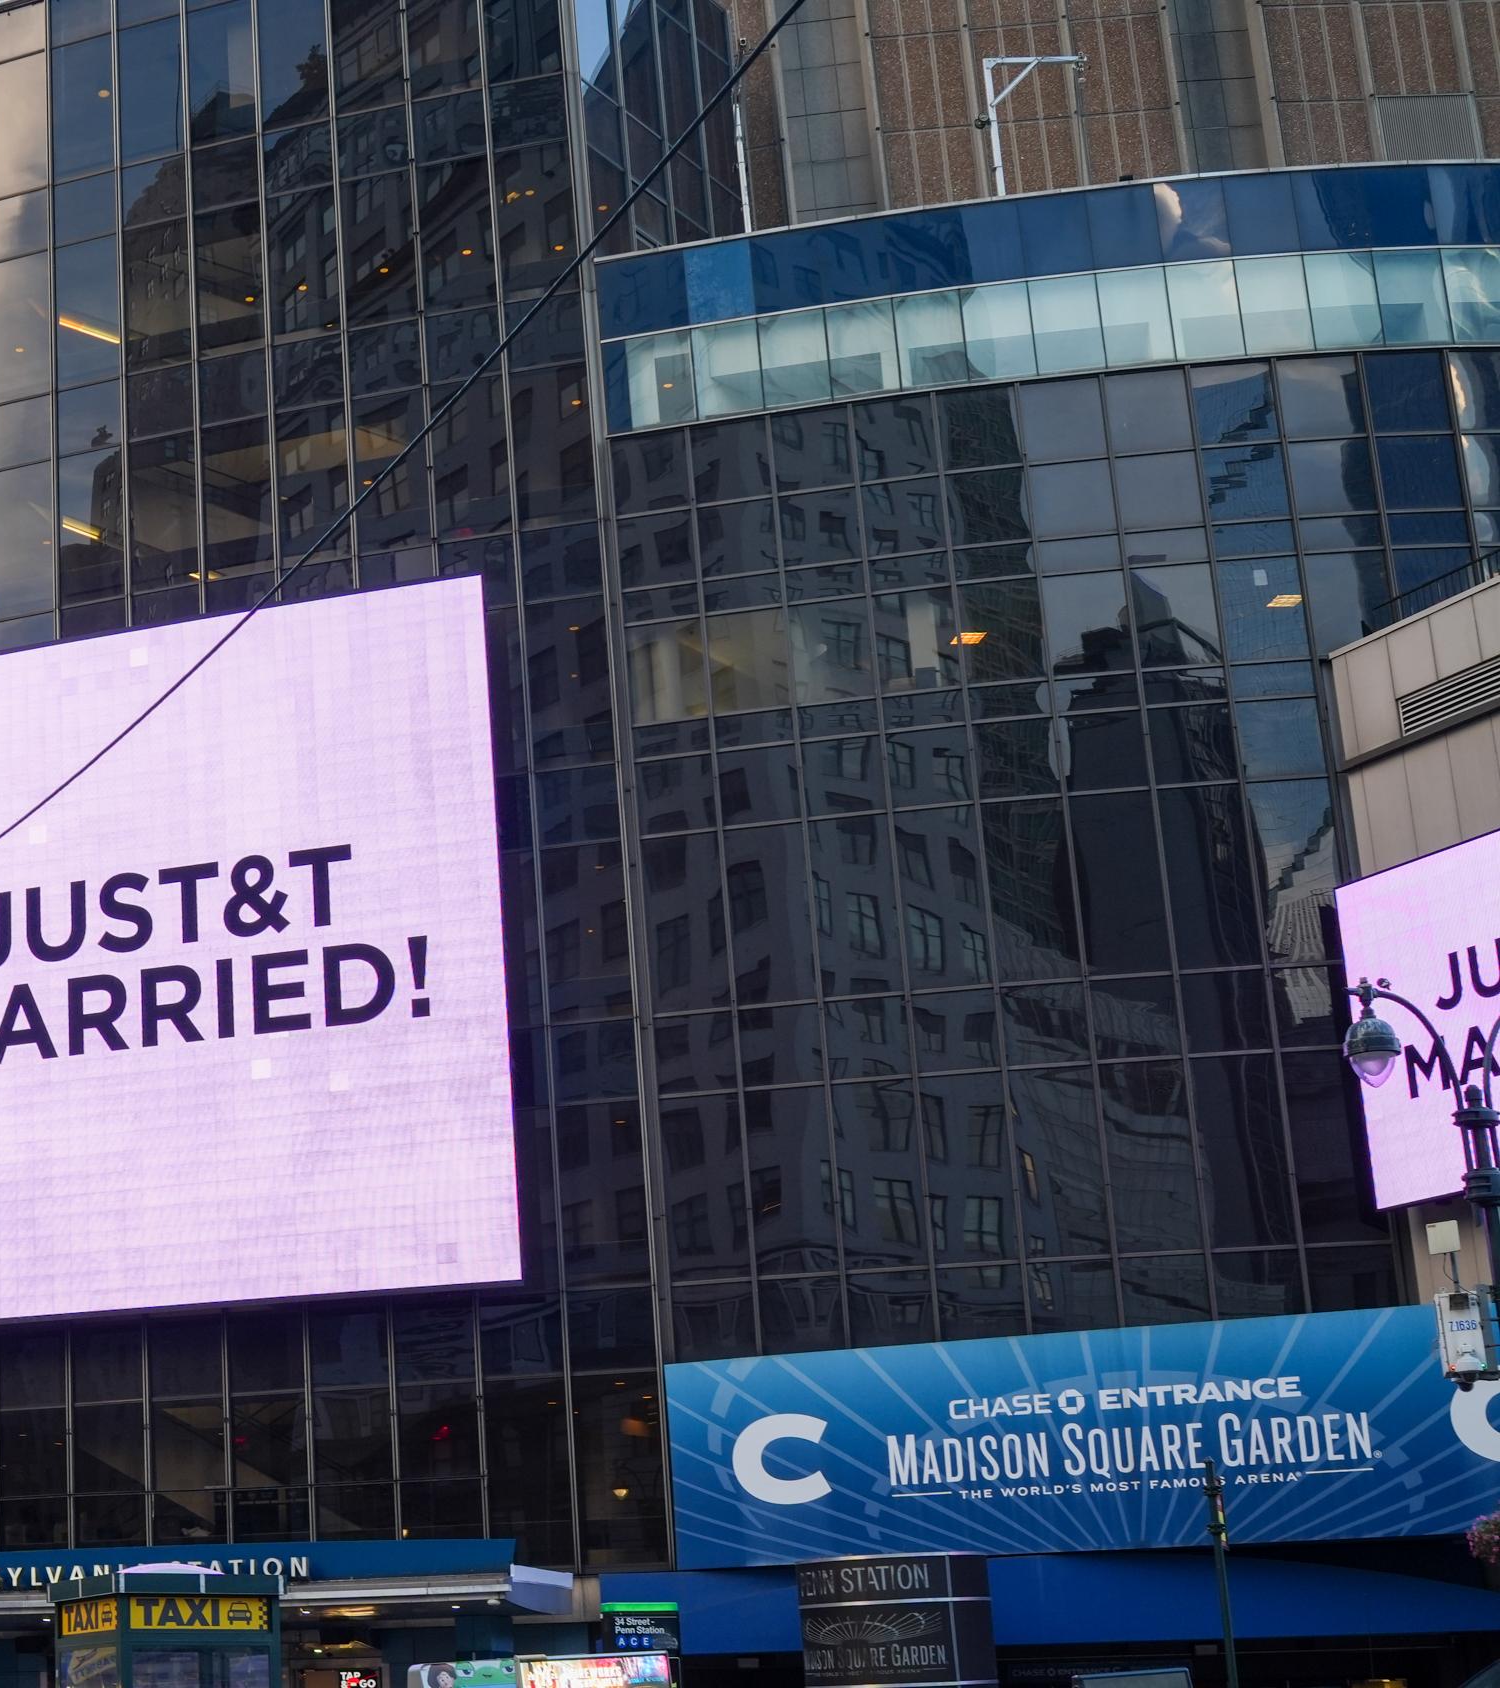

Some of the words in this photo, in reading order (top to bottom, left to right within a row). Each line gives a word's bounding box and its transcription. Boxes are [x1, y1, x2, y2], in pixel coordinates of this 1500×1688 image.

[948, 1393, 1053, 1420] CHASE
[1098, 1375, 1302, 1411] ENTRANCE
[732, 1413, 832, 1505] C
[887, 1432, 1050, 1487] MADISON
[1061, 1422, 1205, 1478] SQUARE
[959, 1488, 993, 1500] THE
[1001, 1484, 1082, 1497] WORLD'S
[1090, 1480, 1141, 1493] MOST
[1235, 1471, 1298, 1484] ARENA
[171, 1556, 308, 1577] ATION
[840, 1563, 930, 1594] STATION
[65, 1604, 99, 1633] TAXI
[136, 1599, 220, 1627] TAXI
[614, 1618, 625, 1626] 34
[626, 1618, 650, 1626] Street
[618, 1637, 626, 1646] A
[630, 1637, 638, 1646] C
[643, 1637, 649, 1645] E
[636, 1626, 665, 1634] Station
[891, 1643, 946, 1666] GARDEN
[340, 1671, 361, 1681] TAP
